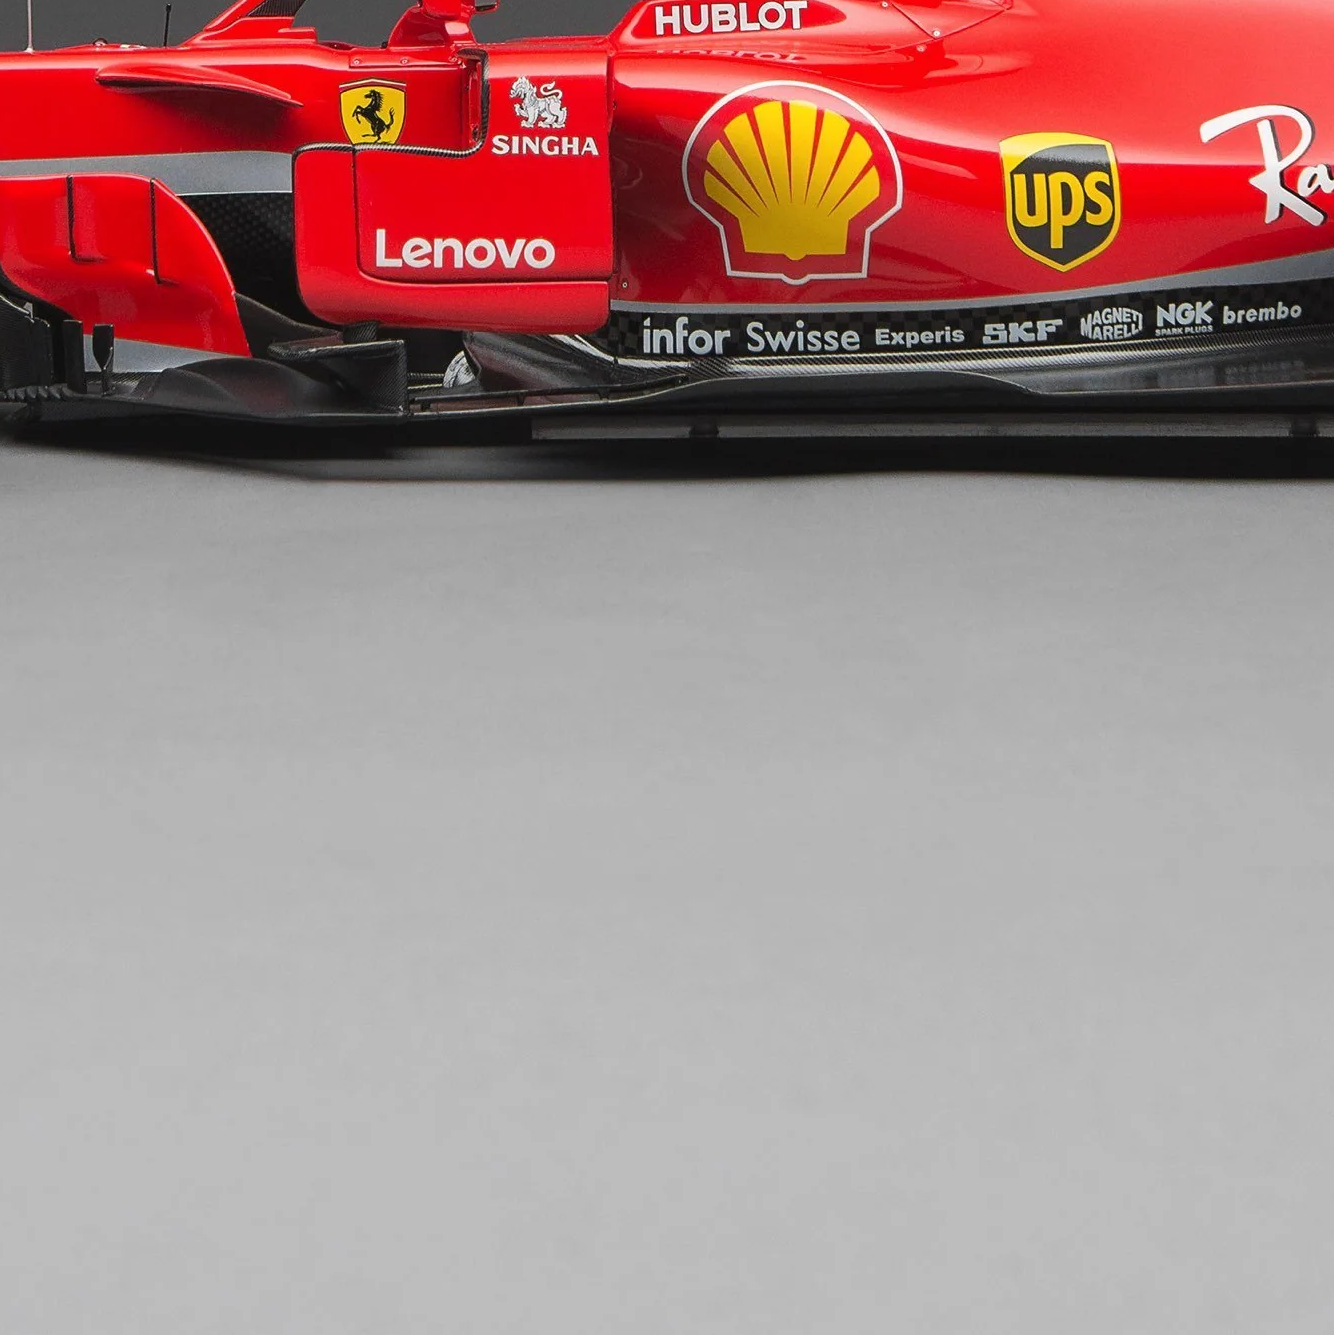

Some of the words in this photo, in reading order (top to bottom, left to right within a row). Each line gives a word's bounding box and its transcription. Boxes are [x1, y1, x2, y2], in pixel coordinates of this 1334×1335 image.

[655, 1, 808, 36] HUBLOT
[491, 135, 599, 156] SINGHA
[376, 229, 555, 269] Lenovo
[1156, 300, 1214, 327] NGK
[1222, 302, 1302, 325] brembo
[643, 317, 731, 355] infor
[746, 320, 860, 352] Swisse
[875, 326, 965, 348] Experis
[982, 319, 1063, 345] SKF
[1155, 326, 1184, 337] SPARK
[1185, 325, 1214, 335] PLUGS
